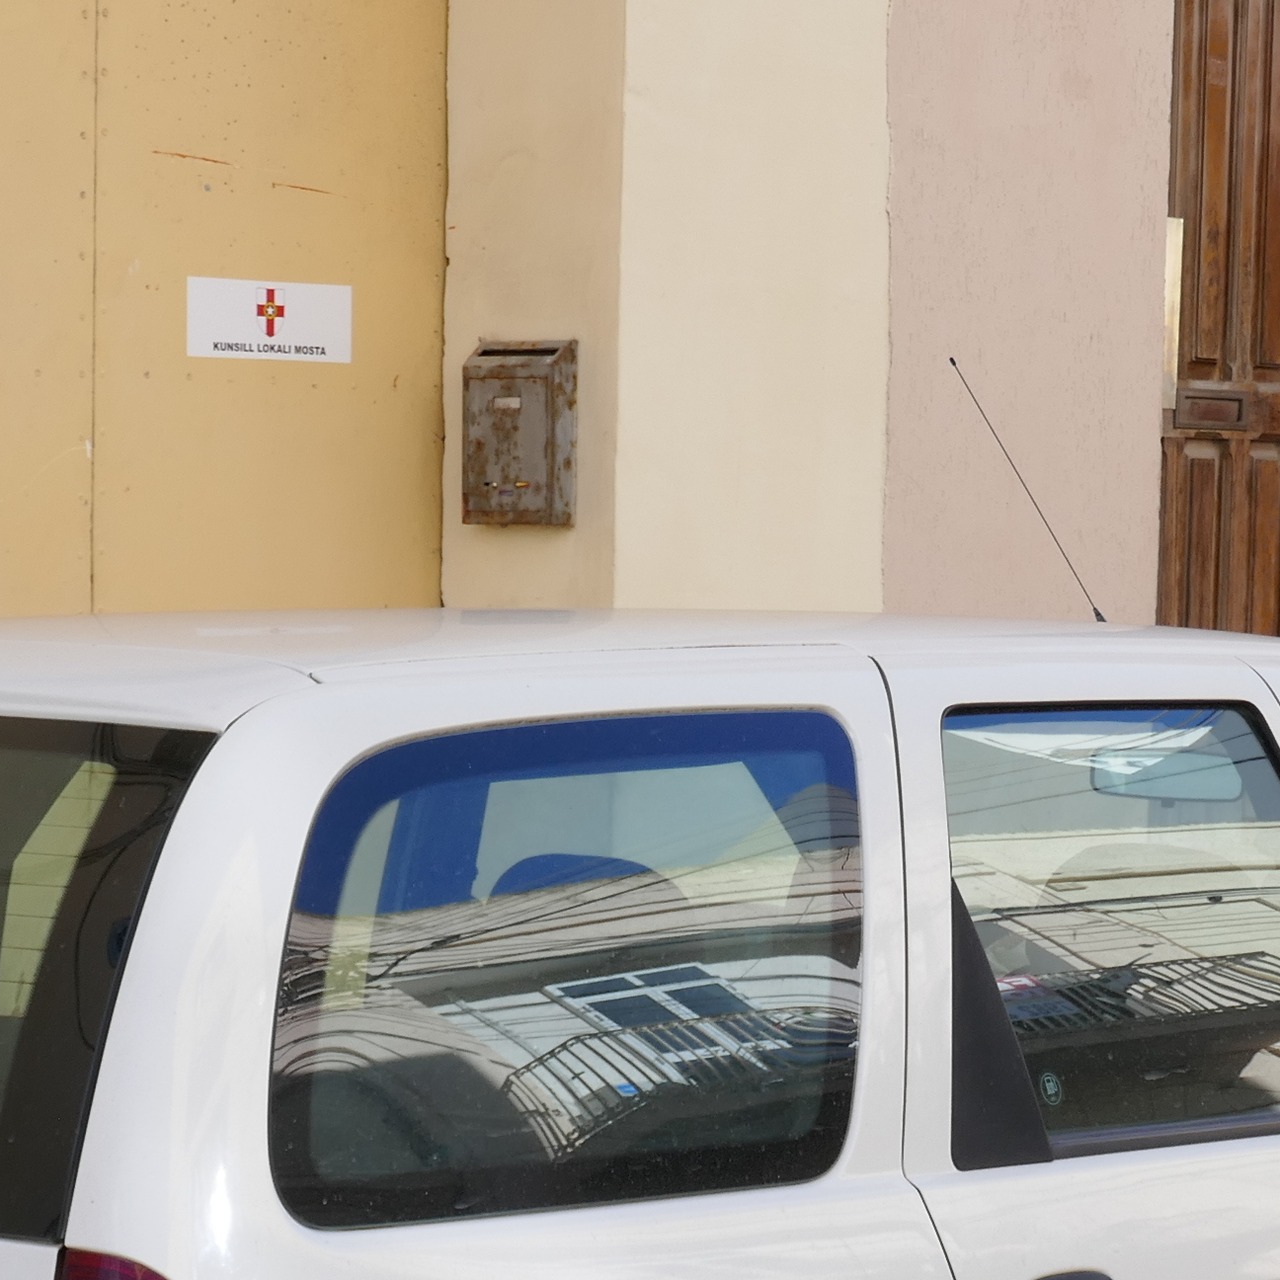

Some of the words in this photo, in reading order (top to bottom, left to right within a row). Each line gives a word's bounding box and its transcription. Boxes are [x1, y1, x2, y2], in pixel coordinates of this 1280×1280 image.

[213, 342, 255, 353] KUNSILL
[257, 343, 292, 354] LOKALI
[294, 345, 327, 356] MOSTA
